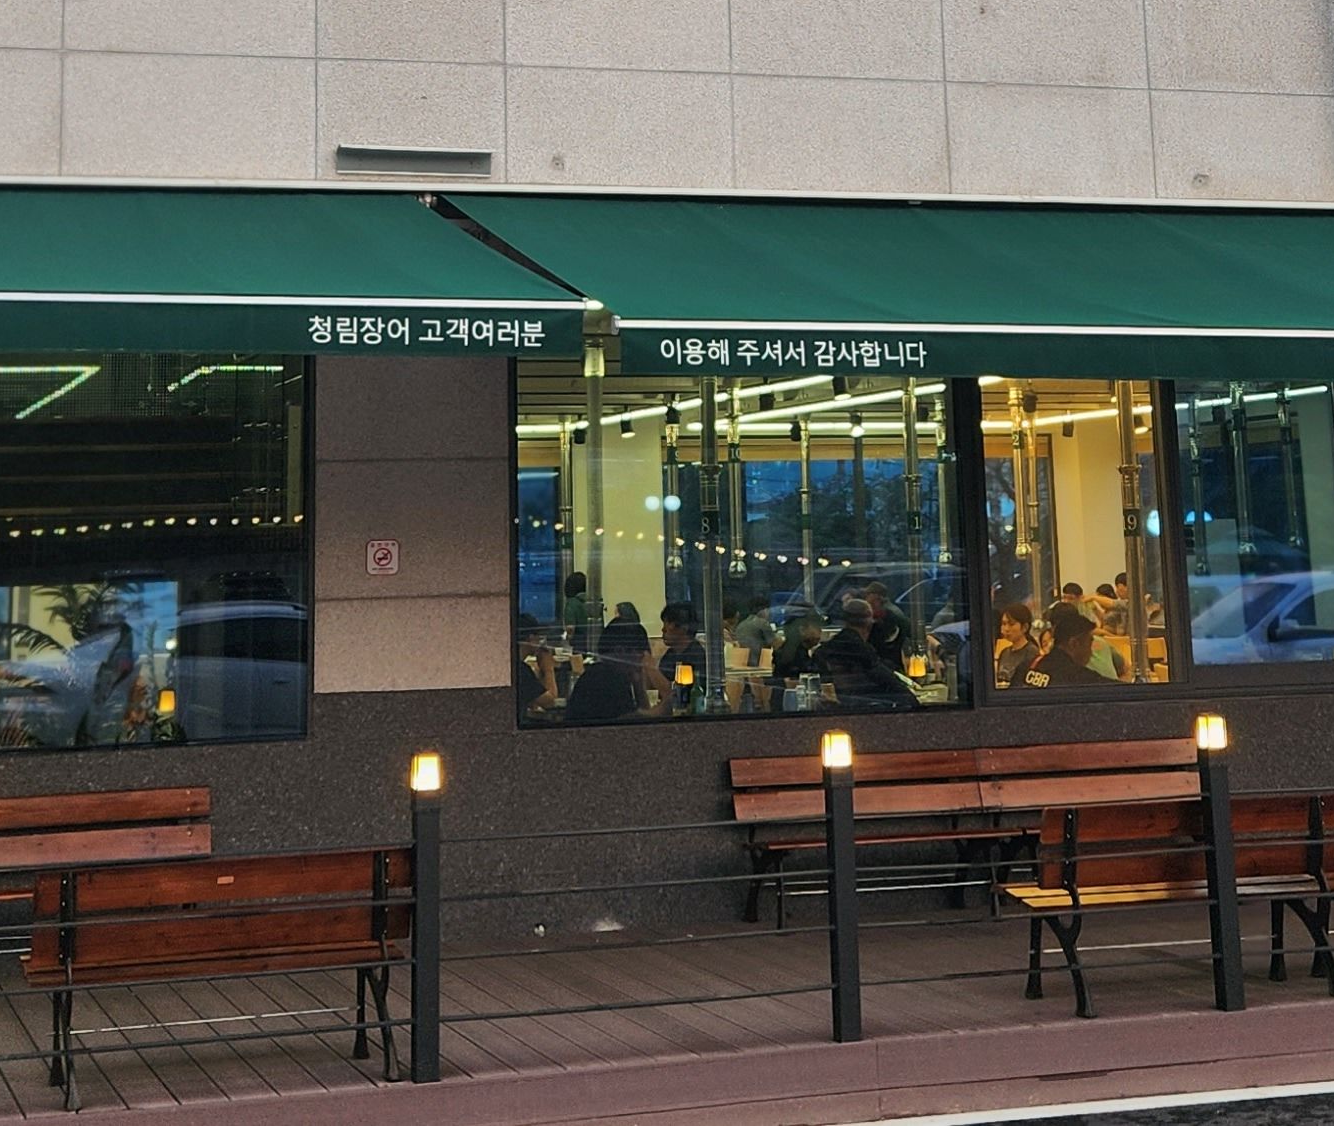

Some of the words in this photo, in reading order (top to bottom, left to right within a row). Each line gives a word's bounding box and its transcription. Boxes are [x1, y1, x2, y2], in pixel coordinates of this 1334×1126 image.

[308, 315, 411, 346] 청림장어
[418, 318, 546, 348] 고객여러분
[660, 338, 730, 366] 이용해
[737, 340, 806, 367] 주셔서
[814, 340, 927, 369] 감사합니다
